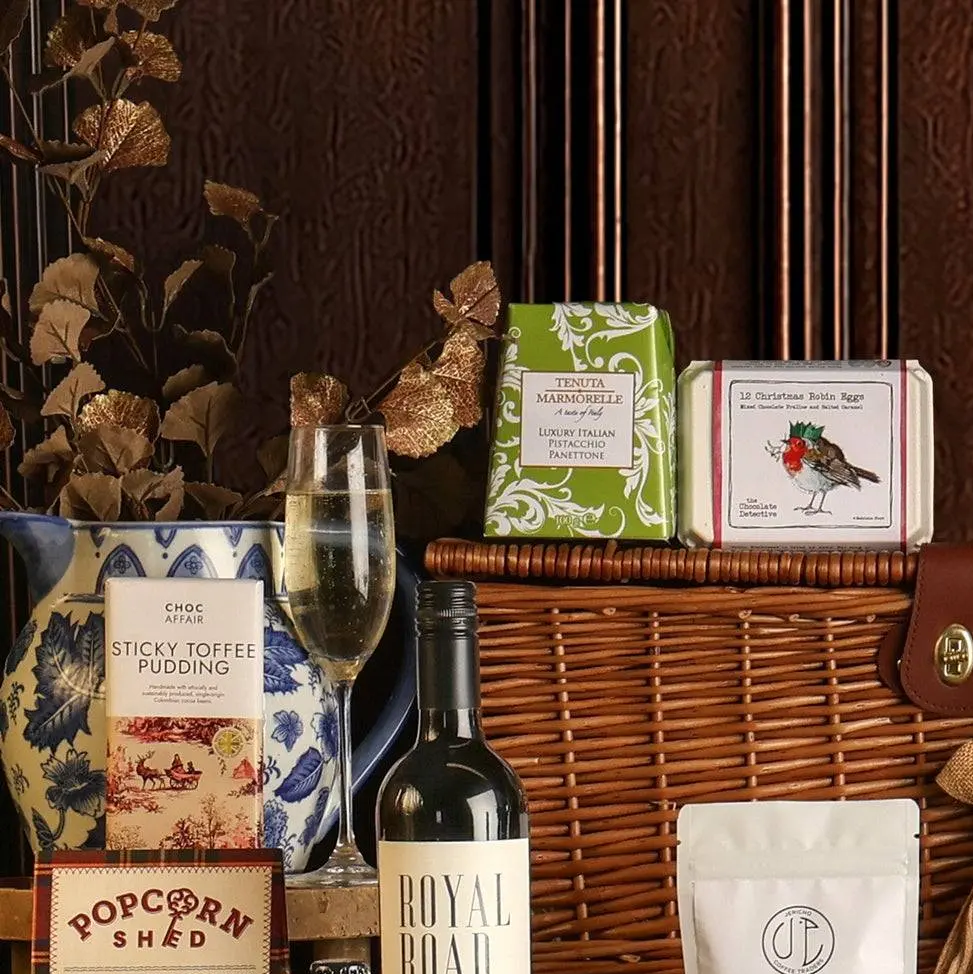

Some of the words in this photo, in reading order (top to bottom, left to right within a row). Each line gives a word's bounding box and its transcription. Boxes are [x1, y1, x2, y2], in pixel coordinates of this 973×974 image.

[555, 377, 605, 388] TENUTA
[536, 393, 624, 404] MARMORELLE
[740, 391, 752, 400] 12
[755, 391, 804, 400] Christmas
[808, 391, 836, 400] Robin
[840, 391, 865, 403] Eggs
[539, 428, 575, 437] LUXURY
[578, 428, 616, 438] ITALIAN
[548, 439, 606, 448] PISTACCHIO
[549, 450, 605, 460] PANETTONE
[739, 510, 777, 518] Detective
[165, 603, 204, 613] CHOC
[164, 615, 204, 624] AFFAIR
[111, 641, 179, 657] STICKY
[186, 642, 256, 659] TOFFEE
[138, 659, 230, 675] PUDDING
[398, 872, 511, 929] ROYAL
[67, 887, 255, 942] POPCORN
[113, 930, 207, 949] SHED
